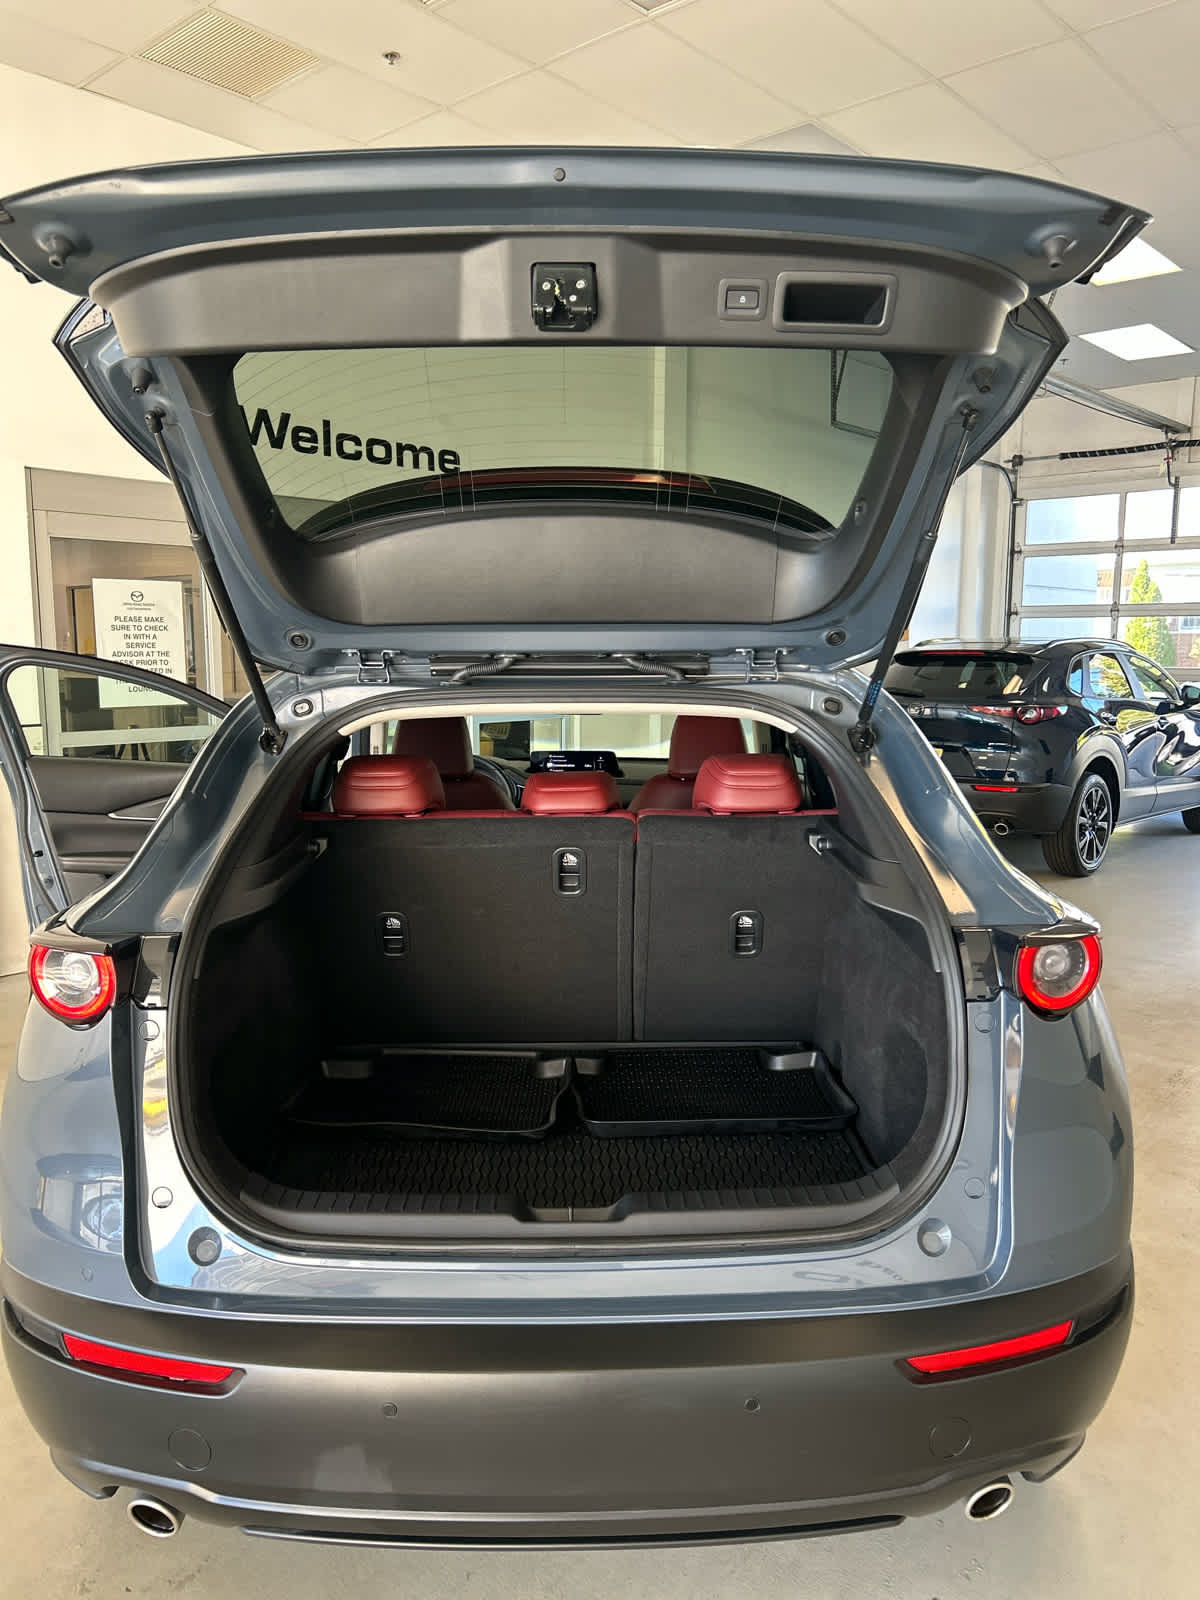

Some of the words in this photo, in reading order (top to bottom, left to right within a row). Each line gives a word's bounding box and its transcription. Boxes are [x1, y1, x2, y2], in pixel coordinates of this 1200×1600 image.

[239, 405, 461, 473] Welcome
[114, 615, 143, 623] PLEASE
[111, 624, 131, 632] SURE
[133, 624, 143, 632] TO
[144, 624, 169, 632] CHECK
[123, 633, 131, 641] IN
[132, 633, 151, 641] WITH
[112, 650, 144, 658] ADVISOR
[145, 650, 155, 658] AT
